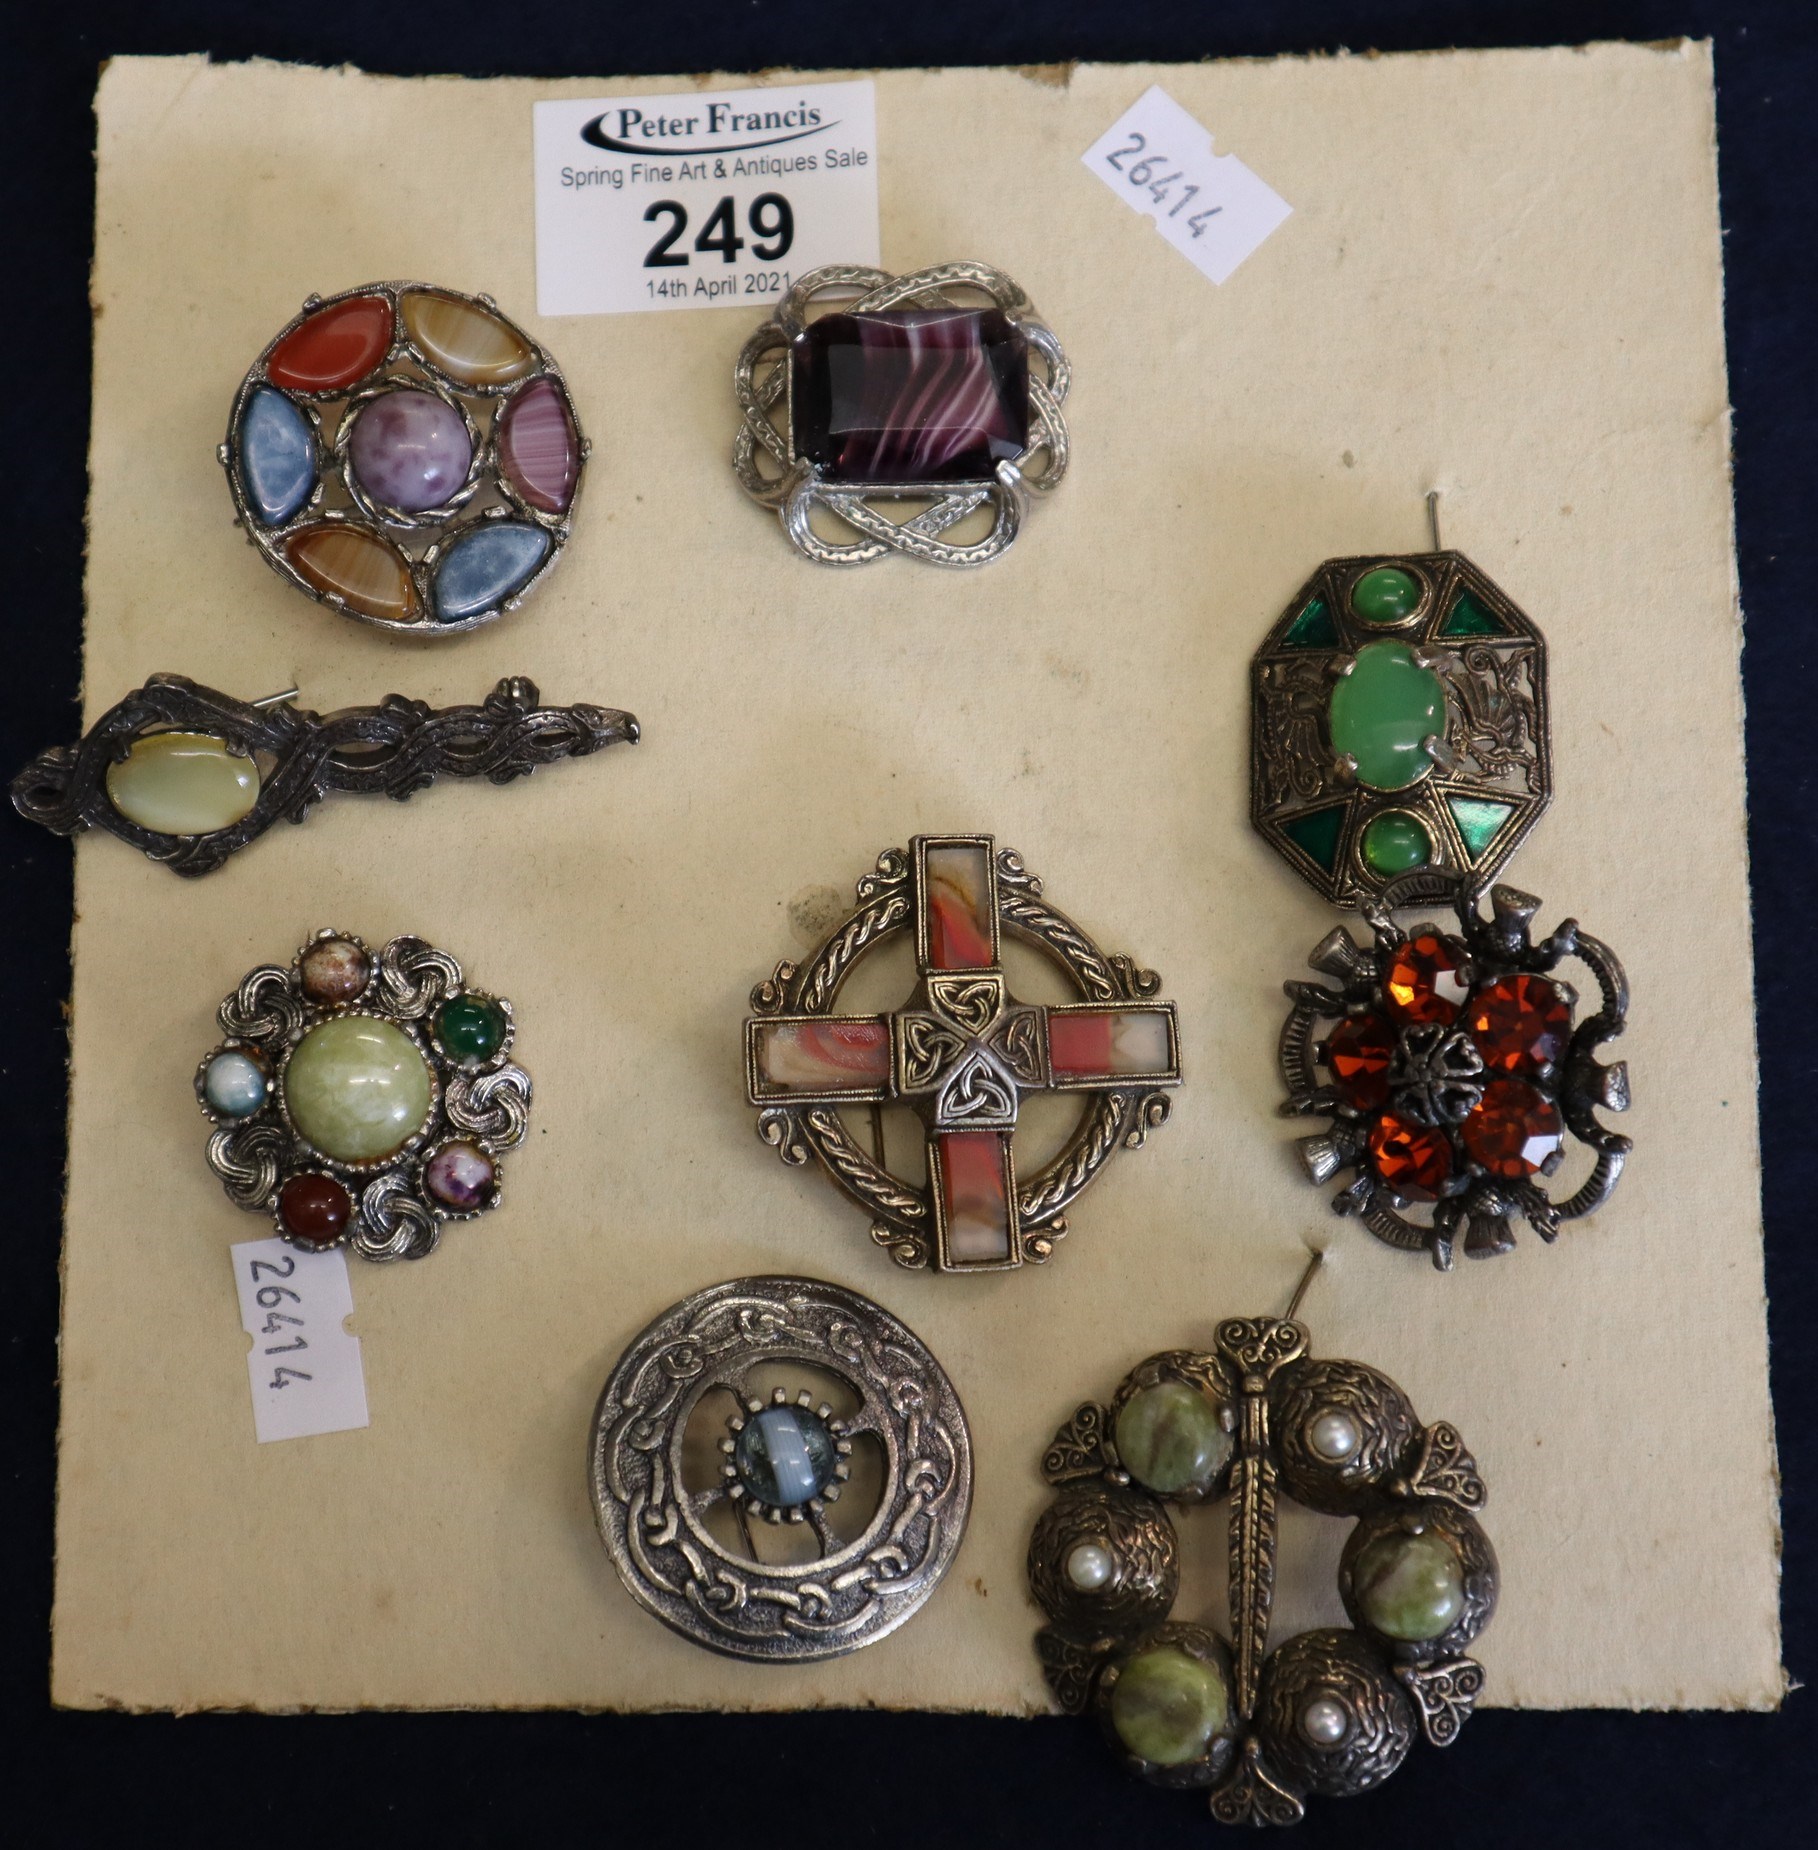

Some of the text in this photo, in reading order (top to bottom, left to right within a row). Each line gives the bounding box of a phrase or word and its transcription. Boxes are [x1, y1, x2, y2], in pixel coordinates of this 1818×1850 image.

[616, 100, 822, 138] Peter Francis
[560, 147, 868, 191] Spring Fine Art & Antiques Sale
[1106, 132, 1223, 239] 26414
[643, 191, 795, 268] 249
[646, 271, 791, 301] 14th April 2021
[250, 1255, 313, 1389] 26414
